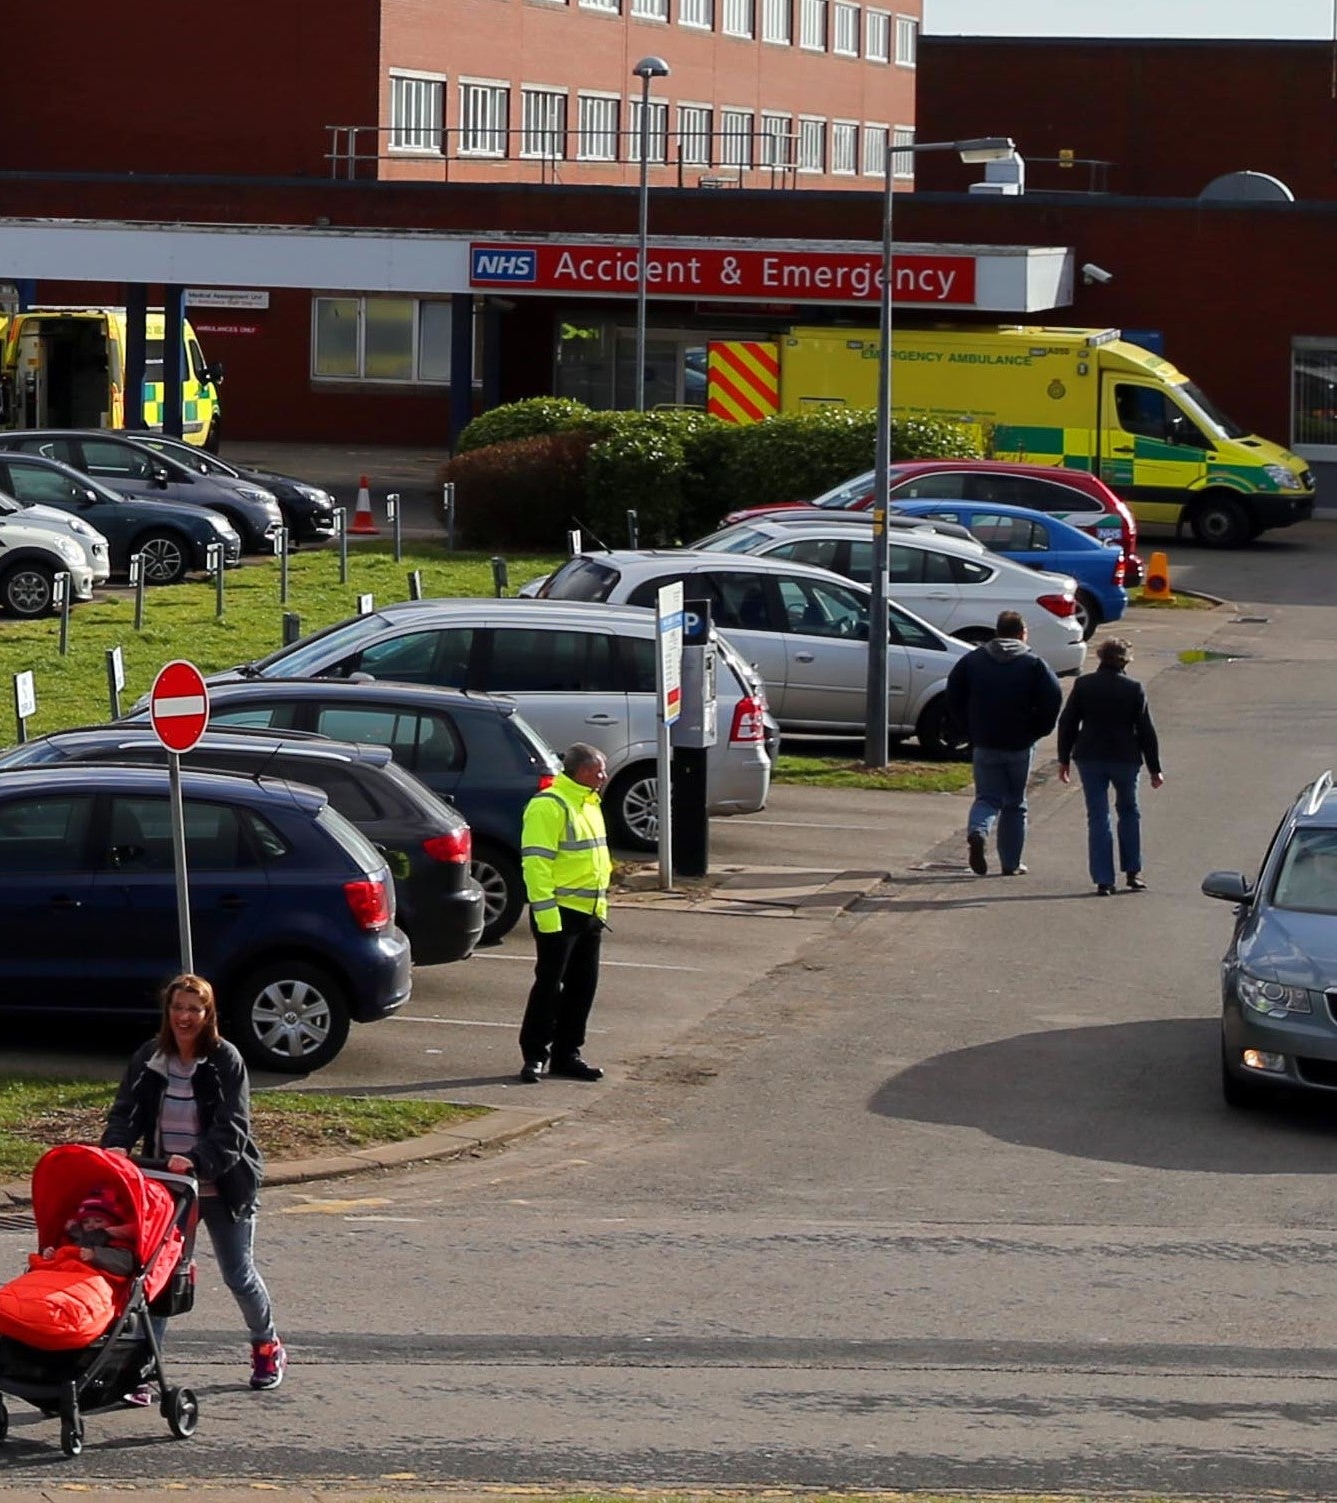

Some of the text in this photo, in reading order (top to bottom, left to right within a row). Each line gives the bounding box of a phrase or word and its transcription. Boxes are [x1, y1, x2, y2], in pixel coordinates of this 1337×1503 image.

[476, 254, 531, 275] NHS
[554, 252, 701, 283] Accident
[720, 257, 742, 284] &
[862, 349, 1033, 366] EMRGENCY AMBULANCE
[685, 612, 699, 634] P
